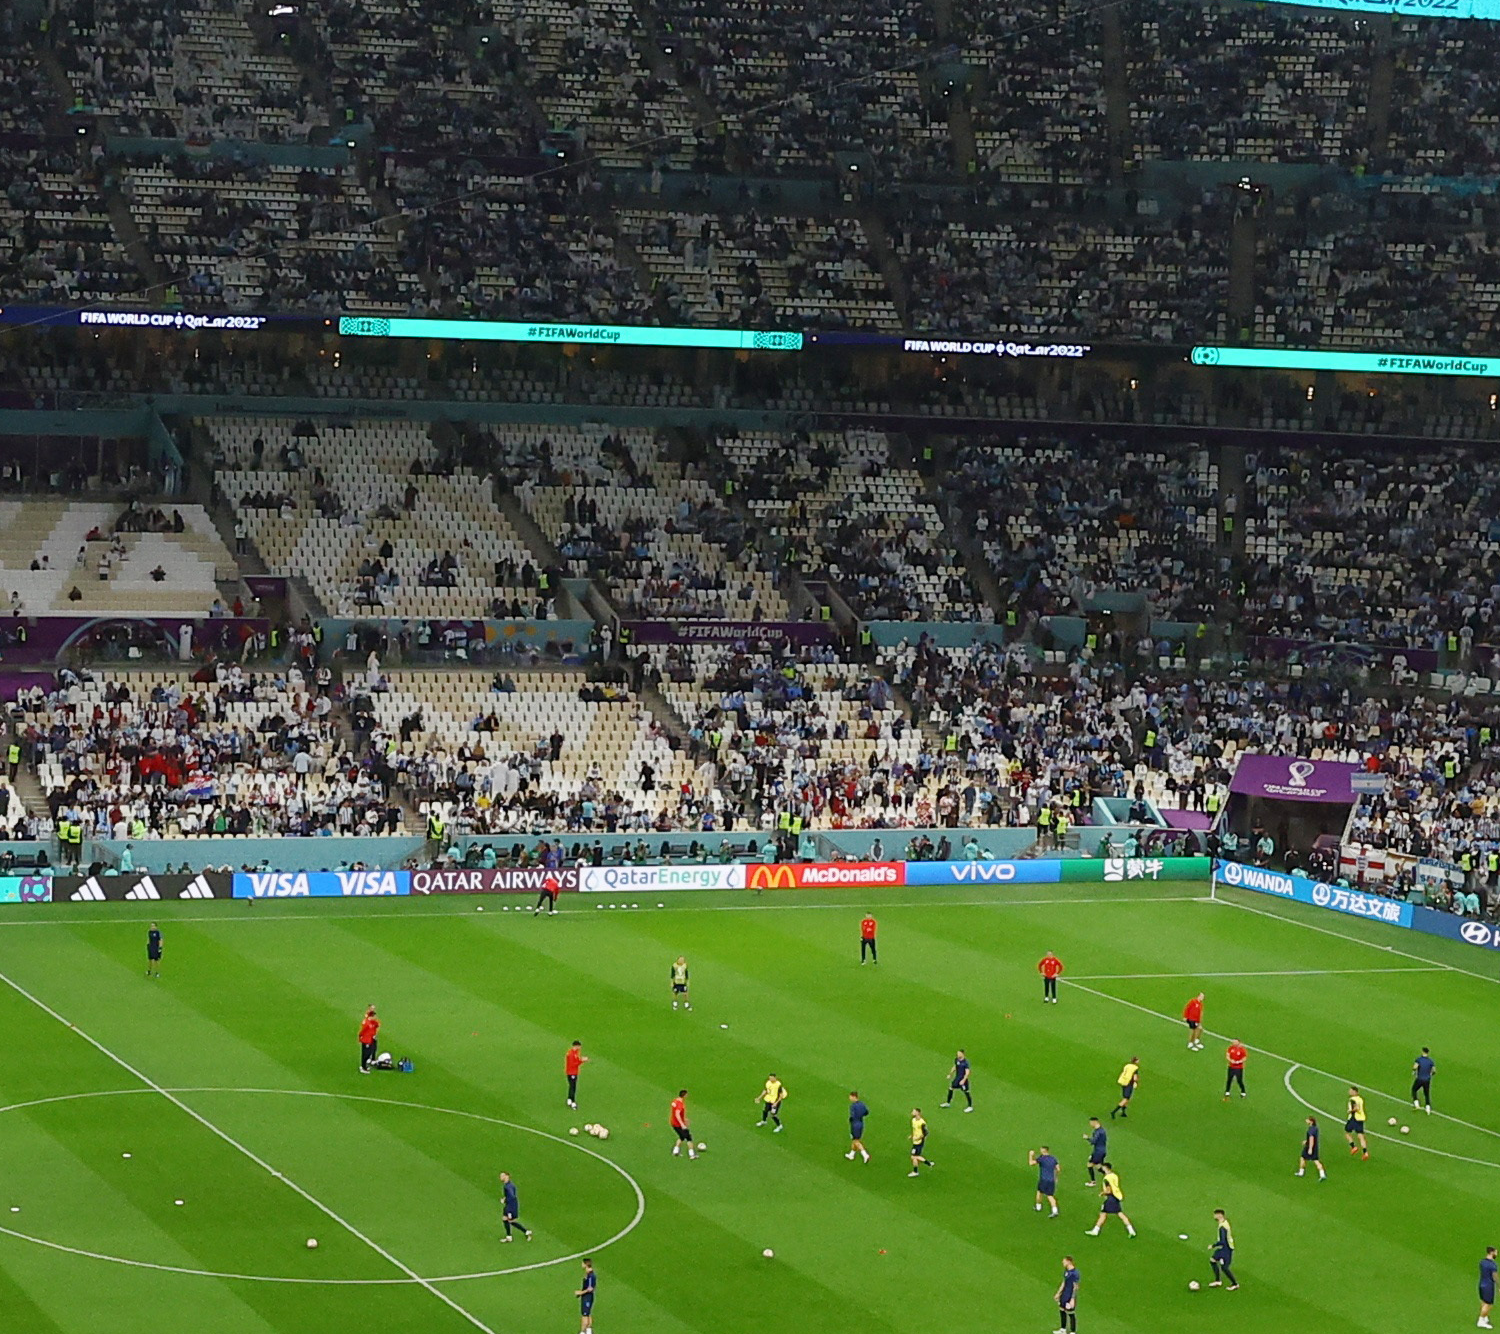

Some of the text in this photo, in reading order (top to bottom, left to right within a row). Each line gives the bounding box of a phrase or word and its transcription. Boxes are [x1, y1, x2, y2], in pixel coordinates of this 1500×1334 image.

[80, 312, 173, 326] FIFA WORLD CUP
[528, 327, 621, 341] #FIFAWorldCup
[904, 340, 995, 353] FIFA WORLD CUP
[1377, 357, 1488, 374] #FIFAWorldCup
[604, 867, 721, 888] QatarEnergy
[801, 866, 897, 884] McDonald's
[950, 860, 1017, 880] vivo
[1126, 858, 1164, 880] 蒙牛
[246, 873, 310, 897] VISA
[335, 871, 397, 896] VISA
[412, 869, 577, 894] QATAR AIRWAYS
[1242, 869, 1295, 896] WANDA
[1330, 888, 1401, 923] 万达文旅
